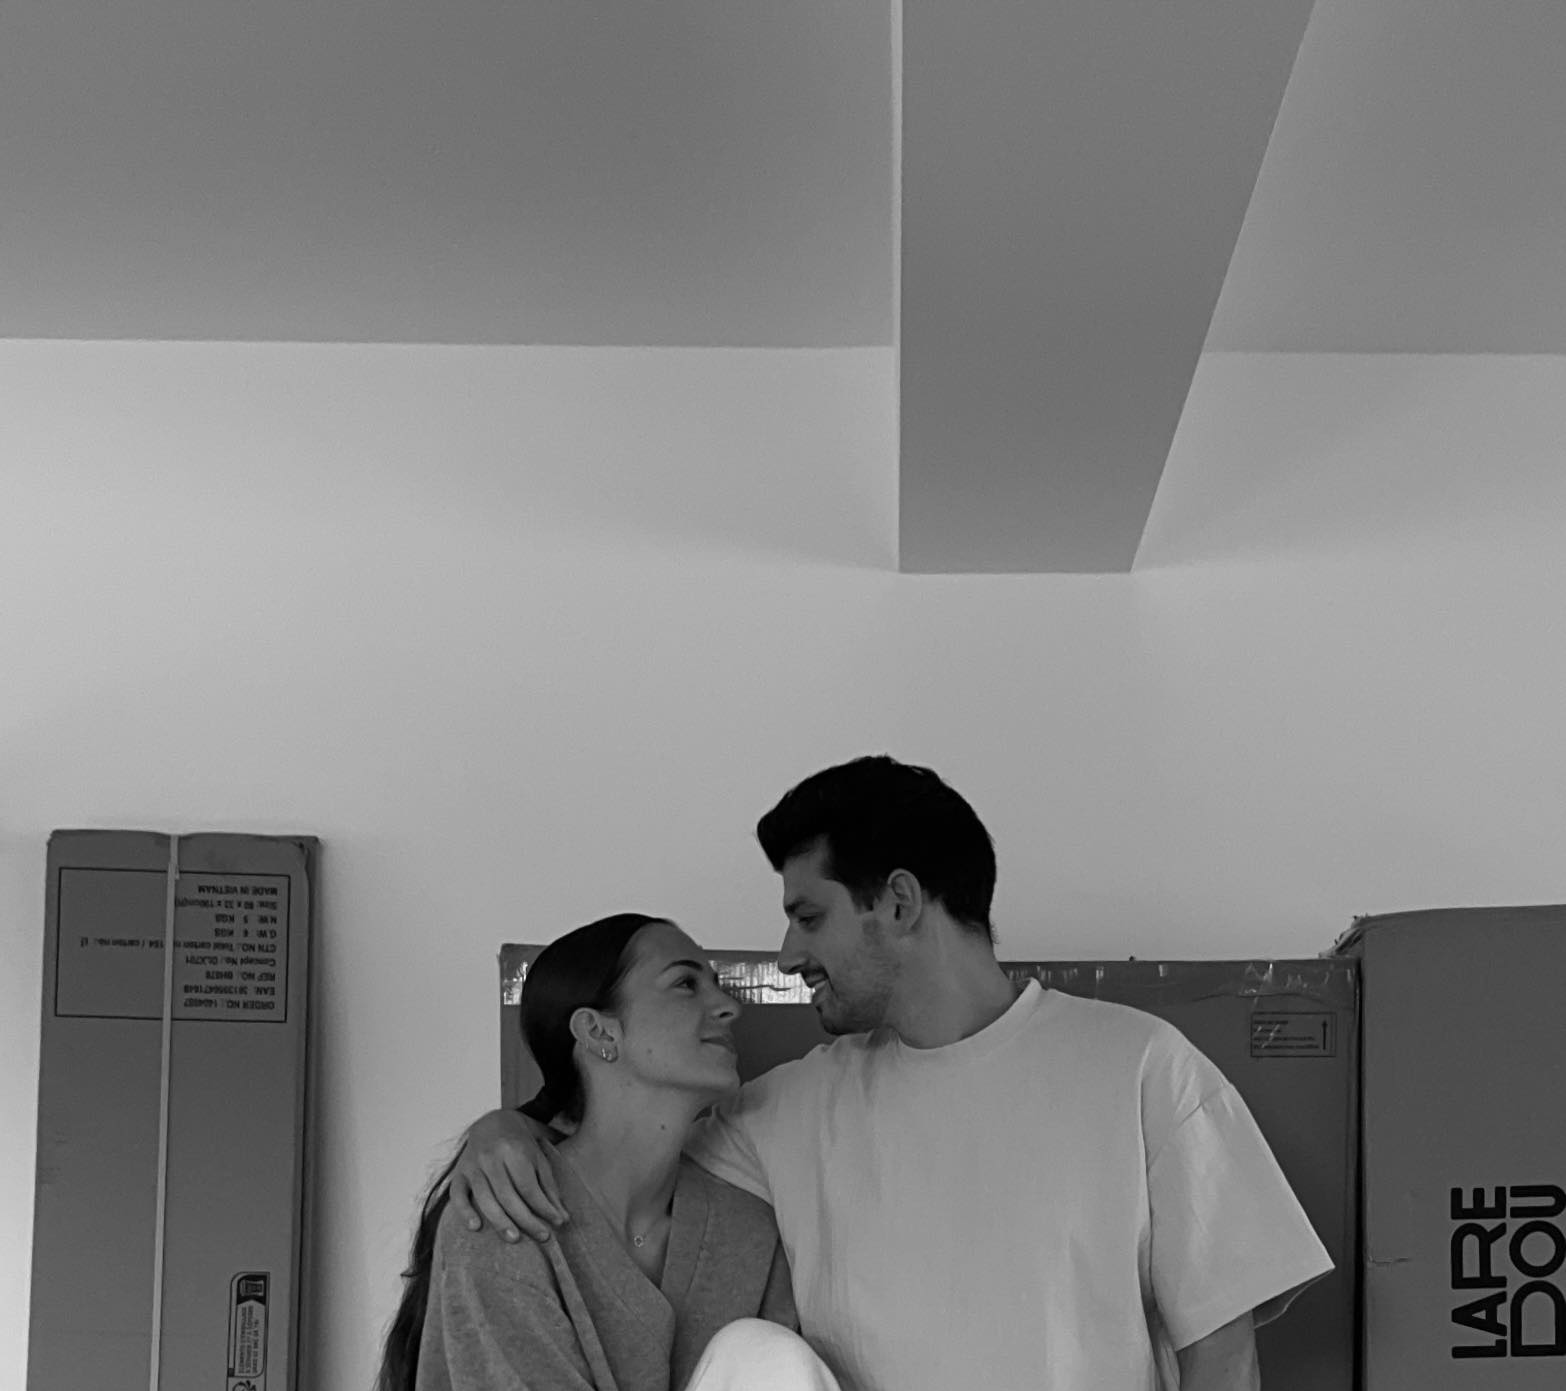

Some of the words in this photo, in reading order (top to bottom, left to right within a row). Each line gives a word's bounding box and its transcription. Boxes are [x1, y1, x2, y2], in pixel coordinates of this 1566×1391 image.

[198, 885, 238, 895] VIETNAM
[1450, 1186, 1507, 1359] LARE
[1509, 1184, 1566, 1358] DOU
